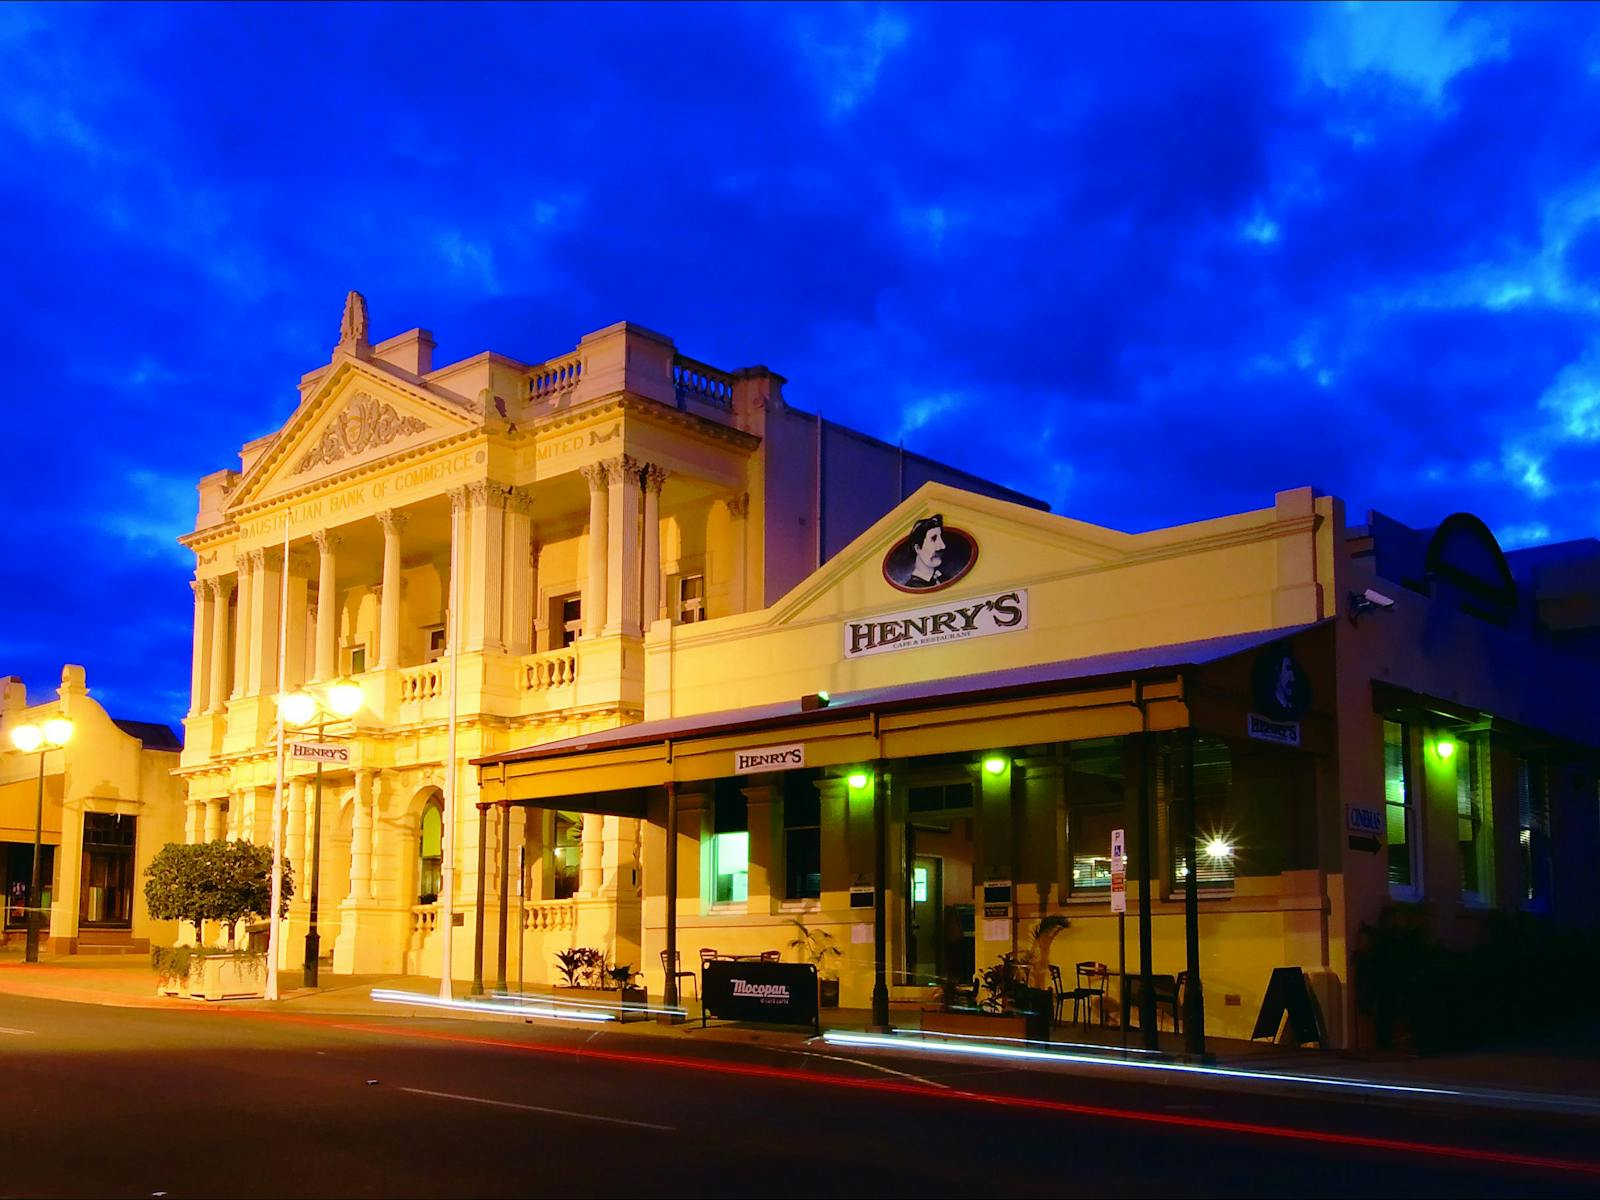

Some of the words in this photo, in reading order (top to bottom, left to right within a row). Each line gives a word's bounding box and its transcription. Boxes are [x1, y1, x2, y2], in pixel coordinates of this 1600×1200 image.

[330, 486, 366, 513] BANK
[373, 479, 390, 498] OF
[395, 452, 471, 491] COMMERCE
[849, 592, 1023, 654] HENRY'S
[920, 631, 971, 645] RESTAURANT
[293, 744, 348, 761] HENRY'S
[738, 748, 802, 770] HENRY'S
[730, 979, 789, 997] Mocopan
